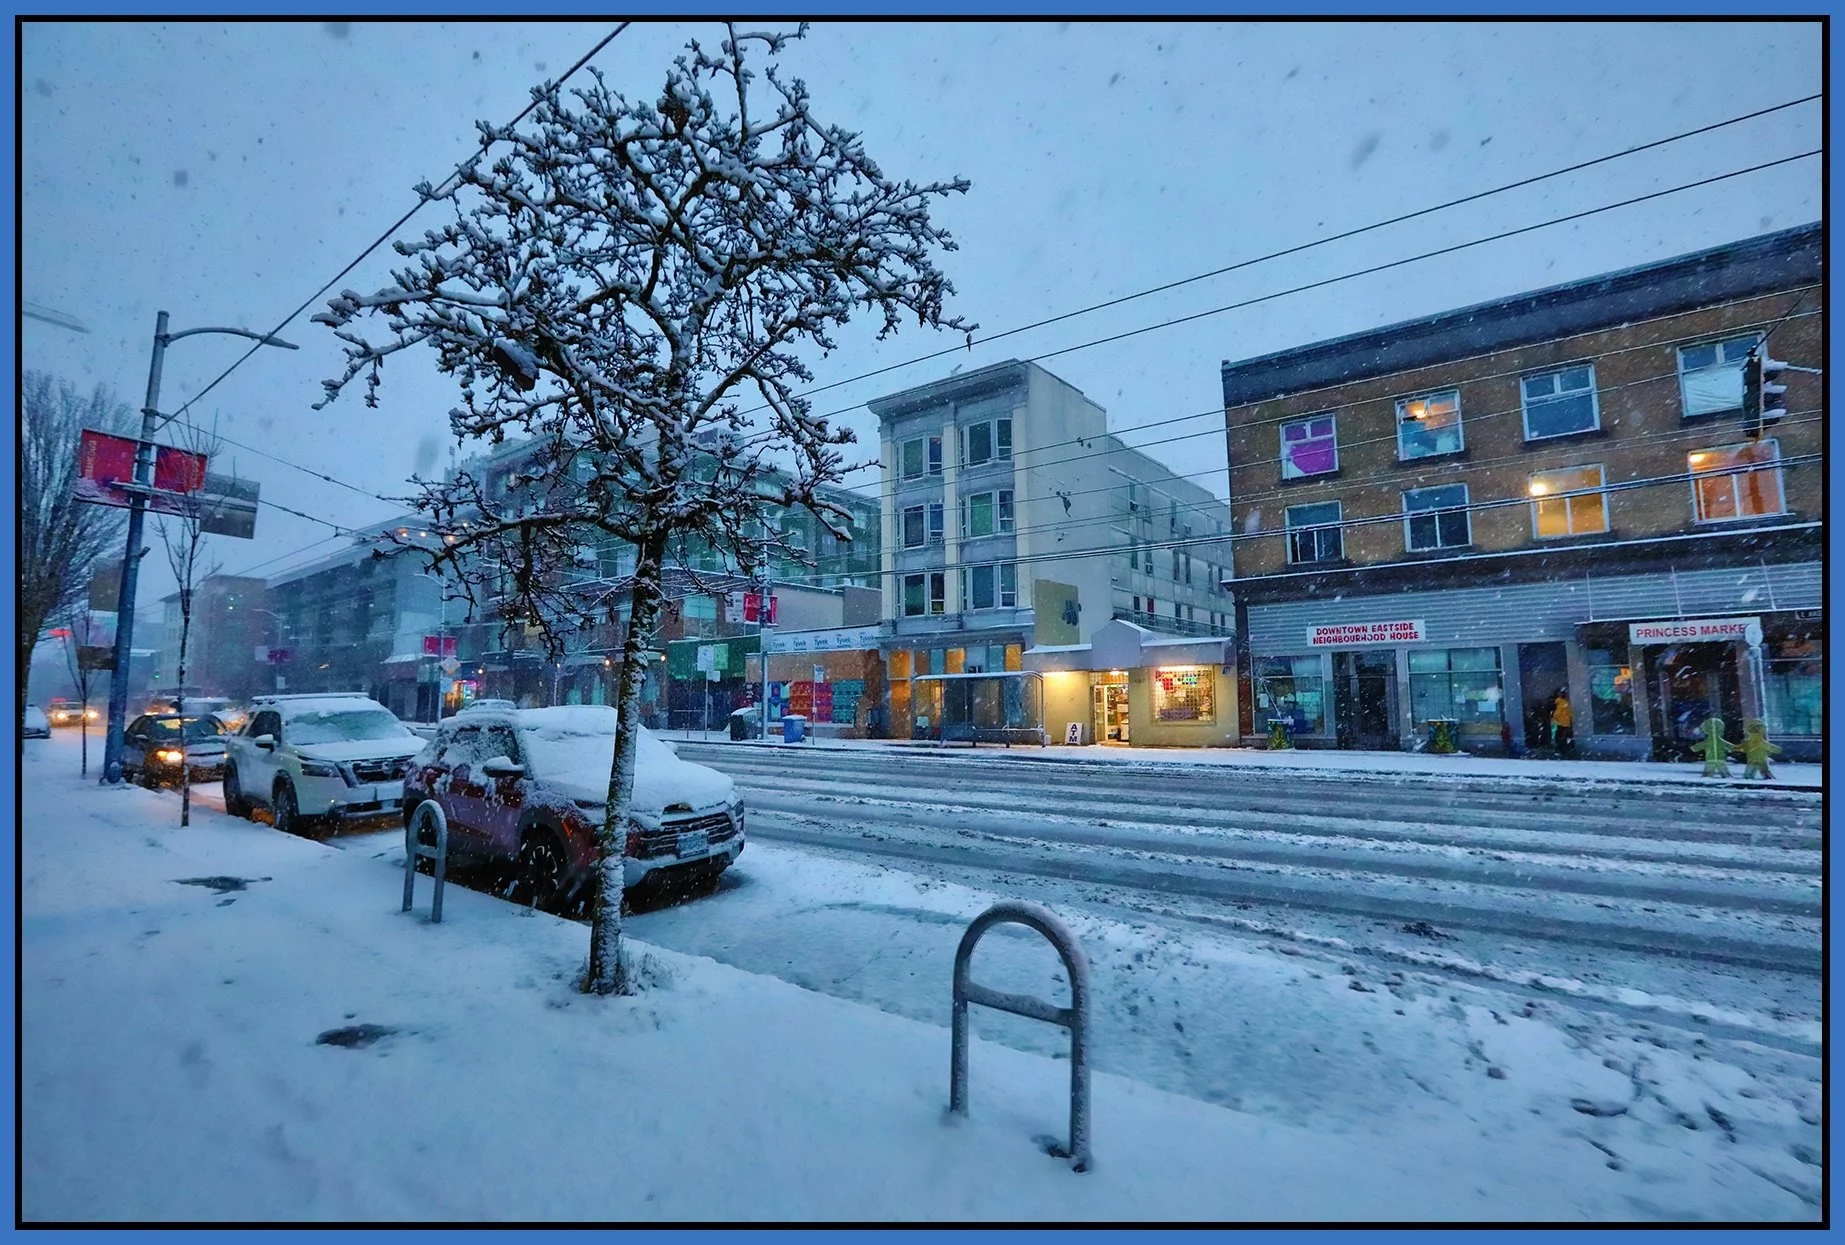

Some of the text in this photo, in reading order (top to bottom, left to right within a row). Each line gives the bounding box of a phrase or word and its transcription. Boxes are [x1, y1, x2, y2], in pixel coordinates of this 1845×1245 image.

[1316, 623, 1414, 635] DOWNTOWN EASTSIDE
[1636, 624, 1748, 638] PRINCESS MARKE
[1312, 632, 1419, 644] NEIGHBOURHOOD HOUSE
[1068, 723, 1078, 743] ATM
